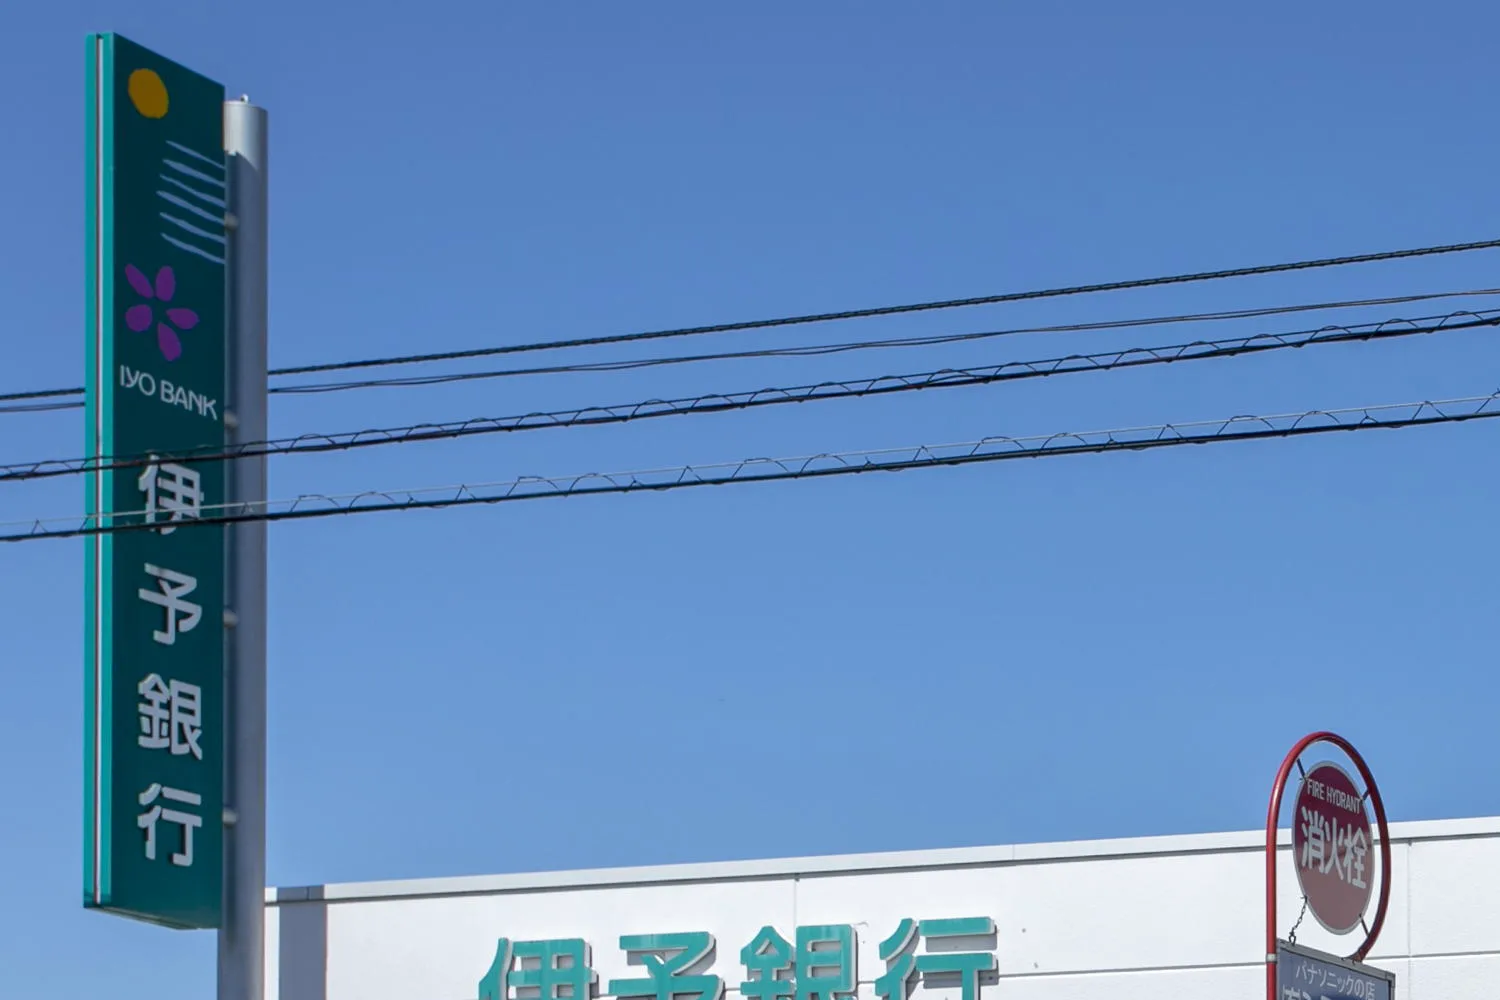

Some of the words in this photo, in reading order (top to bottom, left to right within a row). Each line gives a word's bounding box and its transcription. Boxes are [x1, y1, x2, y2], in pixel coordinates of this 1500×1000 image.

[120, 365, 156, 396] IYO
[160, 379, 218, 420] BANK
[138, 454, 204, 867] 伊予銀行
[1307, 779, 1325, 801] FIRE
[1326, 786, 1361, 814] HYDRANT
[1301, 806, 1368, 889] 消火栓
